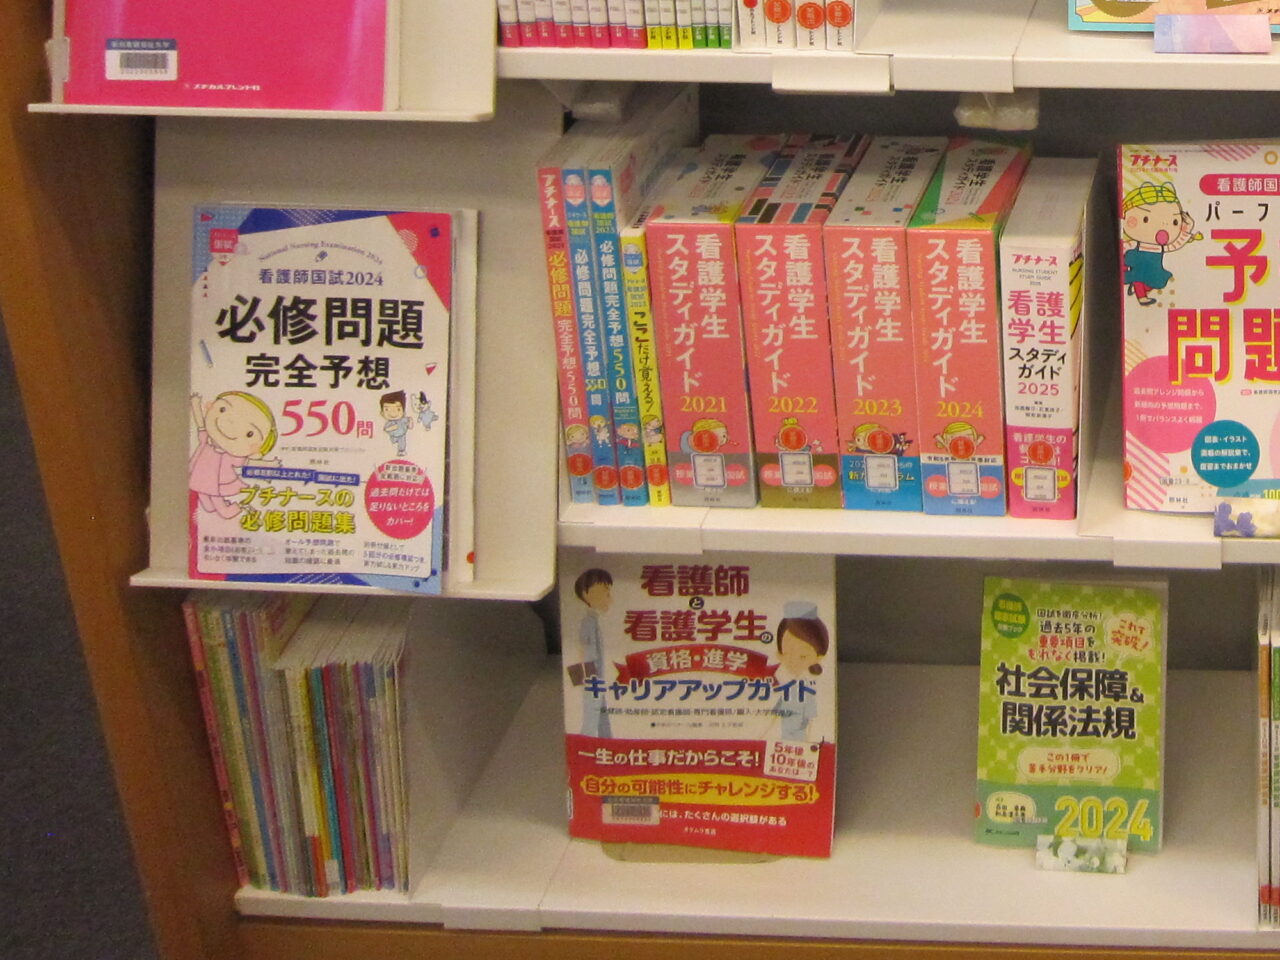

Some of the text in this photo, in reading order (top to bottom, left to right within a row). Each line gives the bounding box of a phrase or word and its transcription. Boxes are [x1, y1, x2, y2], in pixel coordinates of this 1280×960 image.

[259, 269, 384, 287] 看護師国試2024
[548, 251, 573, 317] 必修問題
[694, 233, 730, 339] 看護学生
[783, 233, 818, 340] 看護学生
[871, 237, 903, 342] 看護学生
[957, 238, 987, 344] 看護学生
[665, 234, 702, 393] スタディガイド
[753, 235, 790, 394] スタディガイド
[842, 238, 877, 398] スタディガイド
[926, 239, 959, 398] スタディガイド
[1008, 290, 1065, 317] 看護
[216, 294, 425, 350] 必修問題
[1008, 318, 1066, 344] 学生
[245, 353, 391, 390] 完全予想
[1009, 348, 1067, 363] スタディ
[1018, 365, 1061, 380] ガイド
[680, 396, 727, 414] 2021
[1017, 382, 1059, 396] 2025
[280, 400, 374, 439] 550問
[768, 397, 818, 414] 2022
[853, 399, 902, 416] 2023
[936, 401, 984, 418] 2024
[239, 487, 354, 508] プチナースの
[240, 510, 356, 534] 必修問題集
[640, 565, 750, 597] 看護師
[624, 610, 768, 642] 看護学生
[647, 649, 749, 671] 資格・進学
[584, 677, 817, 702] キャリアアップガイド
[996, 662, 1145, 704] 社会保障&
[1002, 702, 1137, 740] 関係法規
[578, 749, 760, 767] 一生の仕事だからこそ!
[585, 777, 815, 802] 自分の可能性にチャレンジする!
[1055, 795, 1153, 841] 2024
